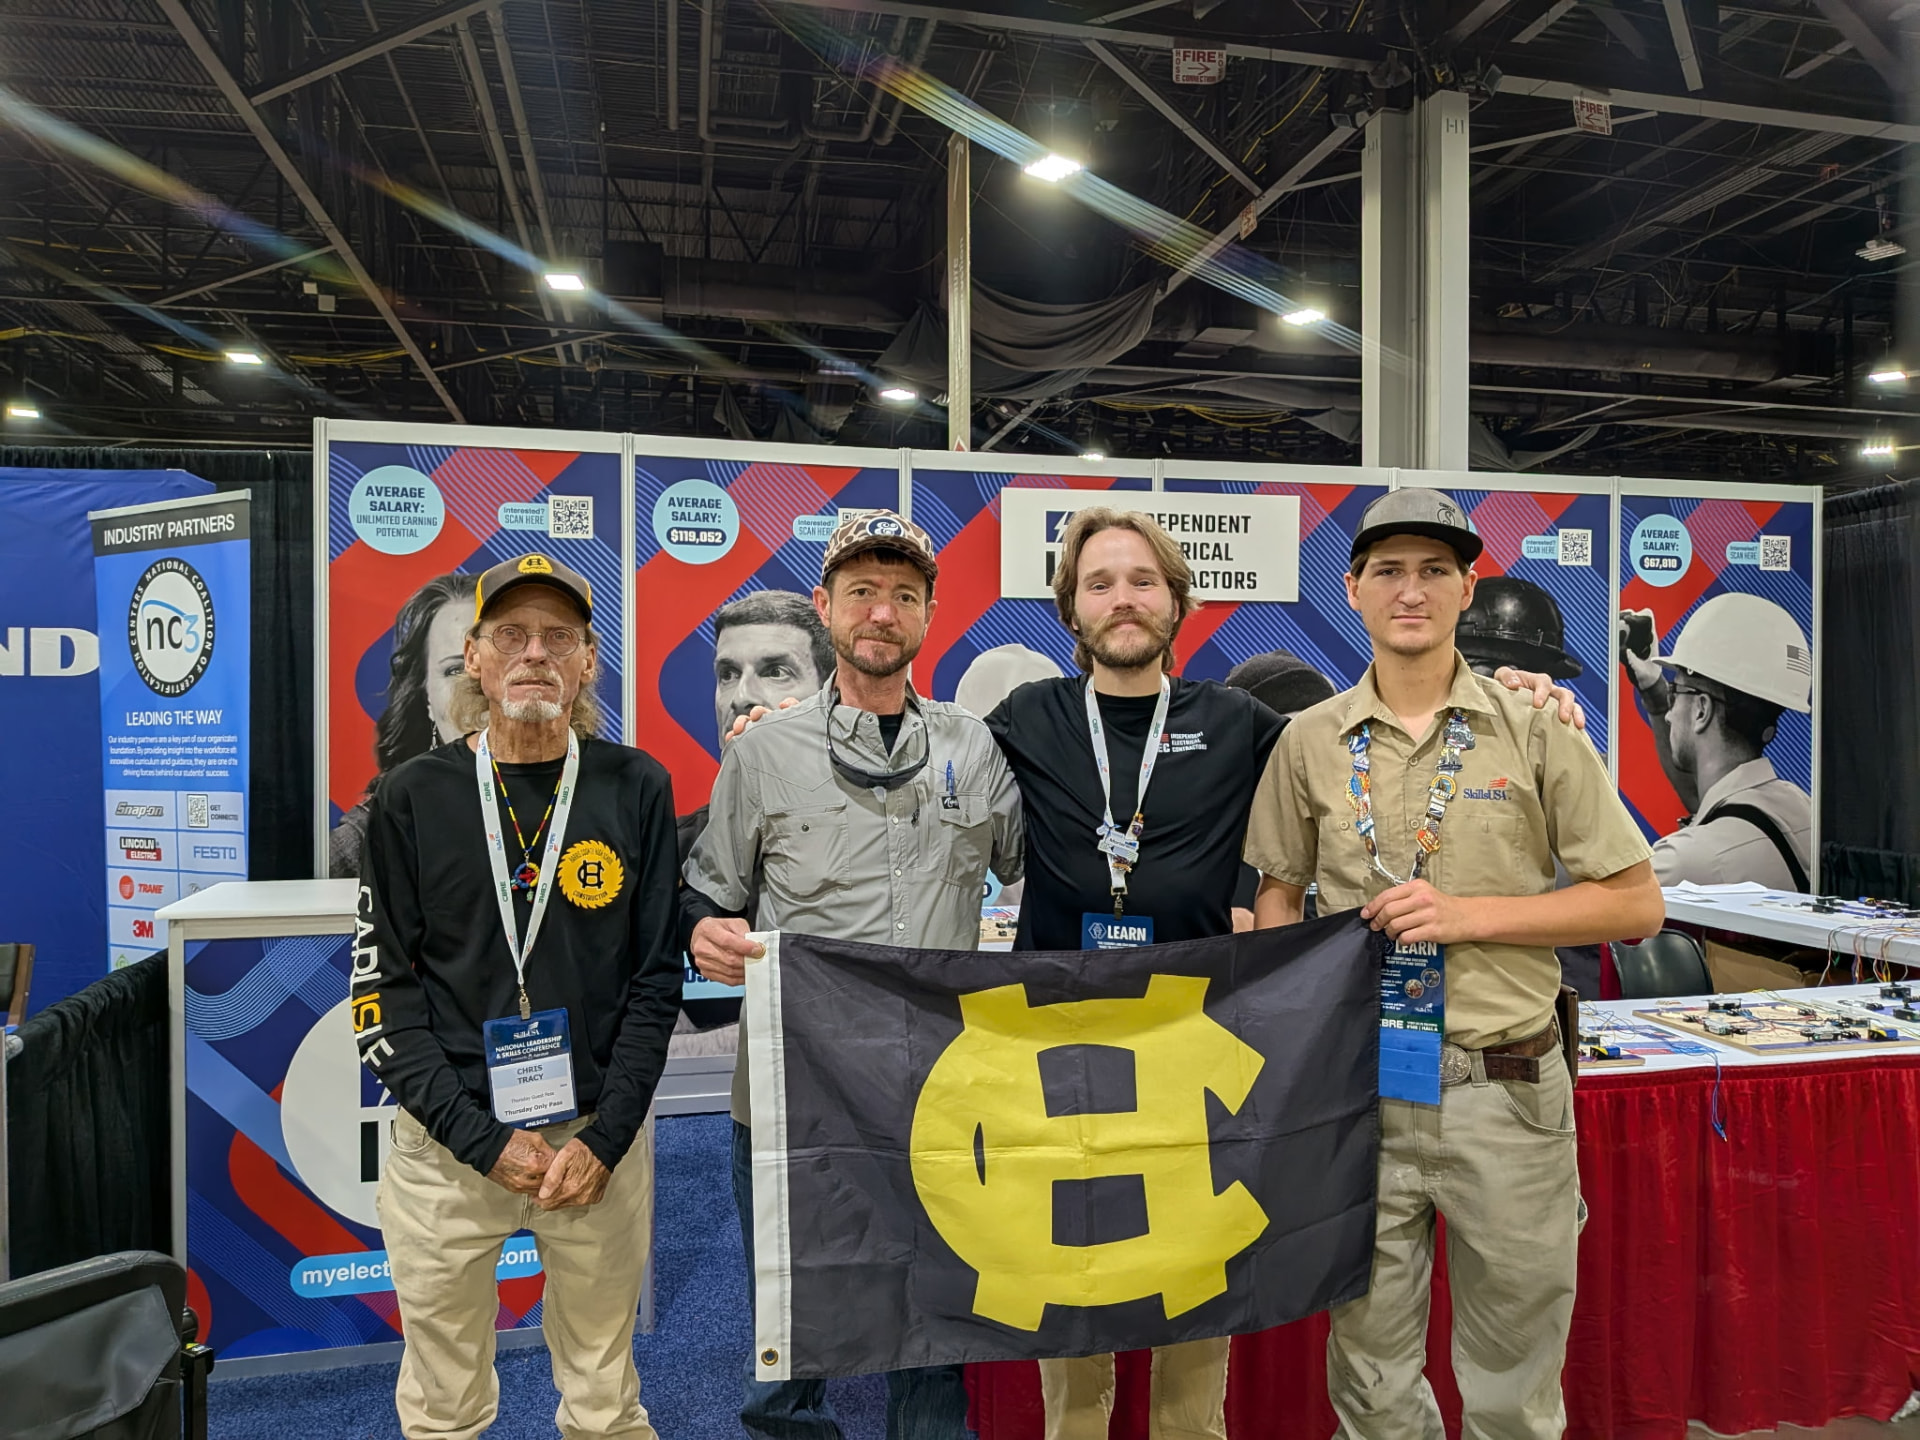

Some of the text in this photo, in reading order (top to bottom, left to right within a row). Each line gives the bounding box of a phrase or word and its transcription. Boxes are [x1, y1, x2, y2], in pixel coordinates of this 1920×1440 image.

[1182, 50, 1217, 62] FIRE
[1580, 100, 1604, 115] FIRE
[365, 485, 425, 498] AVERAGE
[369, 500, 424, 514] SALARY:
[668, 496, 722, 510] AVERAGE
[356, 514, 438, 527] UNLIMITED EARNING
[504, 514, 544, 524] SCAN HERE
[671, 510, 722, 524] SALARY:
[1146, 513, 1251, 534] EPENDENT
[104, 513, 236, 546] INDUSTRY PARTNERS
[376, 527, 420, 538] POTENTIAL
[798, 526, 816, 536] SCAN
[1640, 529, 1680, 540] AVERAGE
[670, 530, 722, 544] $119,052
[1642, 542, 1680, 552] SALARY:
[1730, 552, 1757, 560] SCAN HERE
[1644, 558, 1678, 570] $67,810
[130, 560, 214, 694] NATIONAL COALITION OF CERTIFICATION CENTERS
[126, 709, 222, 726] LEADING THE WAY
[1463, 788, 1507, 800] SkillsUSA
[116, 802, 164, 818] Snap-on
[120, 838, 155, 850] LINCOLN
[130, 851, 158, 860] ELECTRIC
[193, 846, 237, 860] FESTO
[138, 883, 164, 894] TRANE
[132, 920, 154, 939] 3M
[1107, 924, 1147, 942] LEARN
[1395, 940, 1438, 956] LEARN
[496, 1035, 562, 1052] NATIONAL LEADERSHIP
[502, 1050, 522, 1058] SKILLS
[522, 1042, 560, 1054] CONFERENCE
[516, 1064, 543, 1075] CHRIS
[517, 1073, 544, 1084] TRACY
[504, 1106, 533, 1116] Thursday
